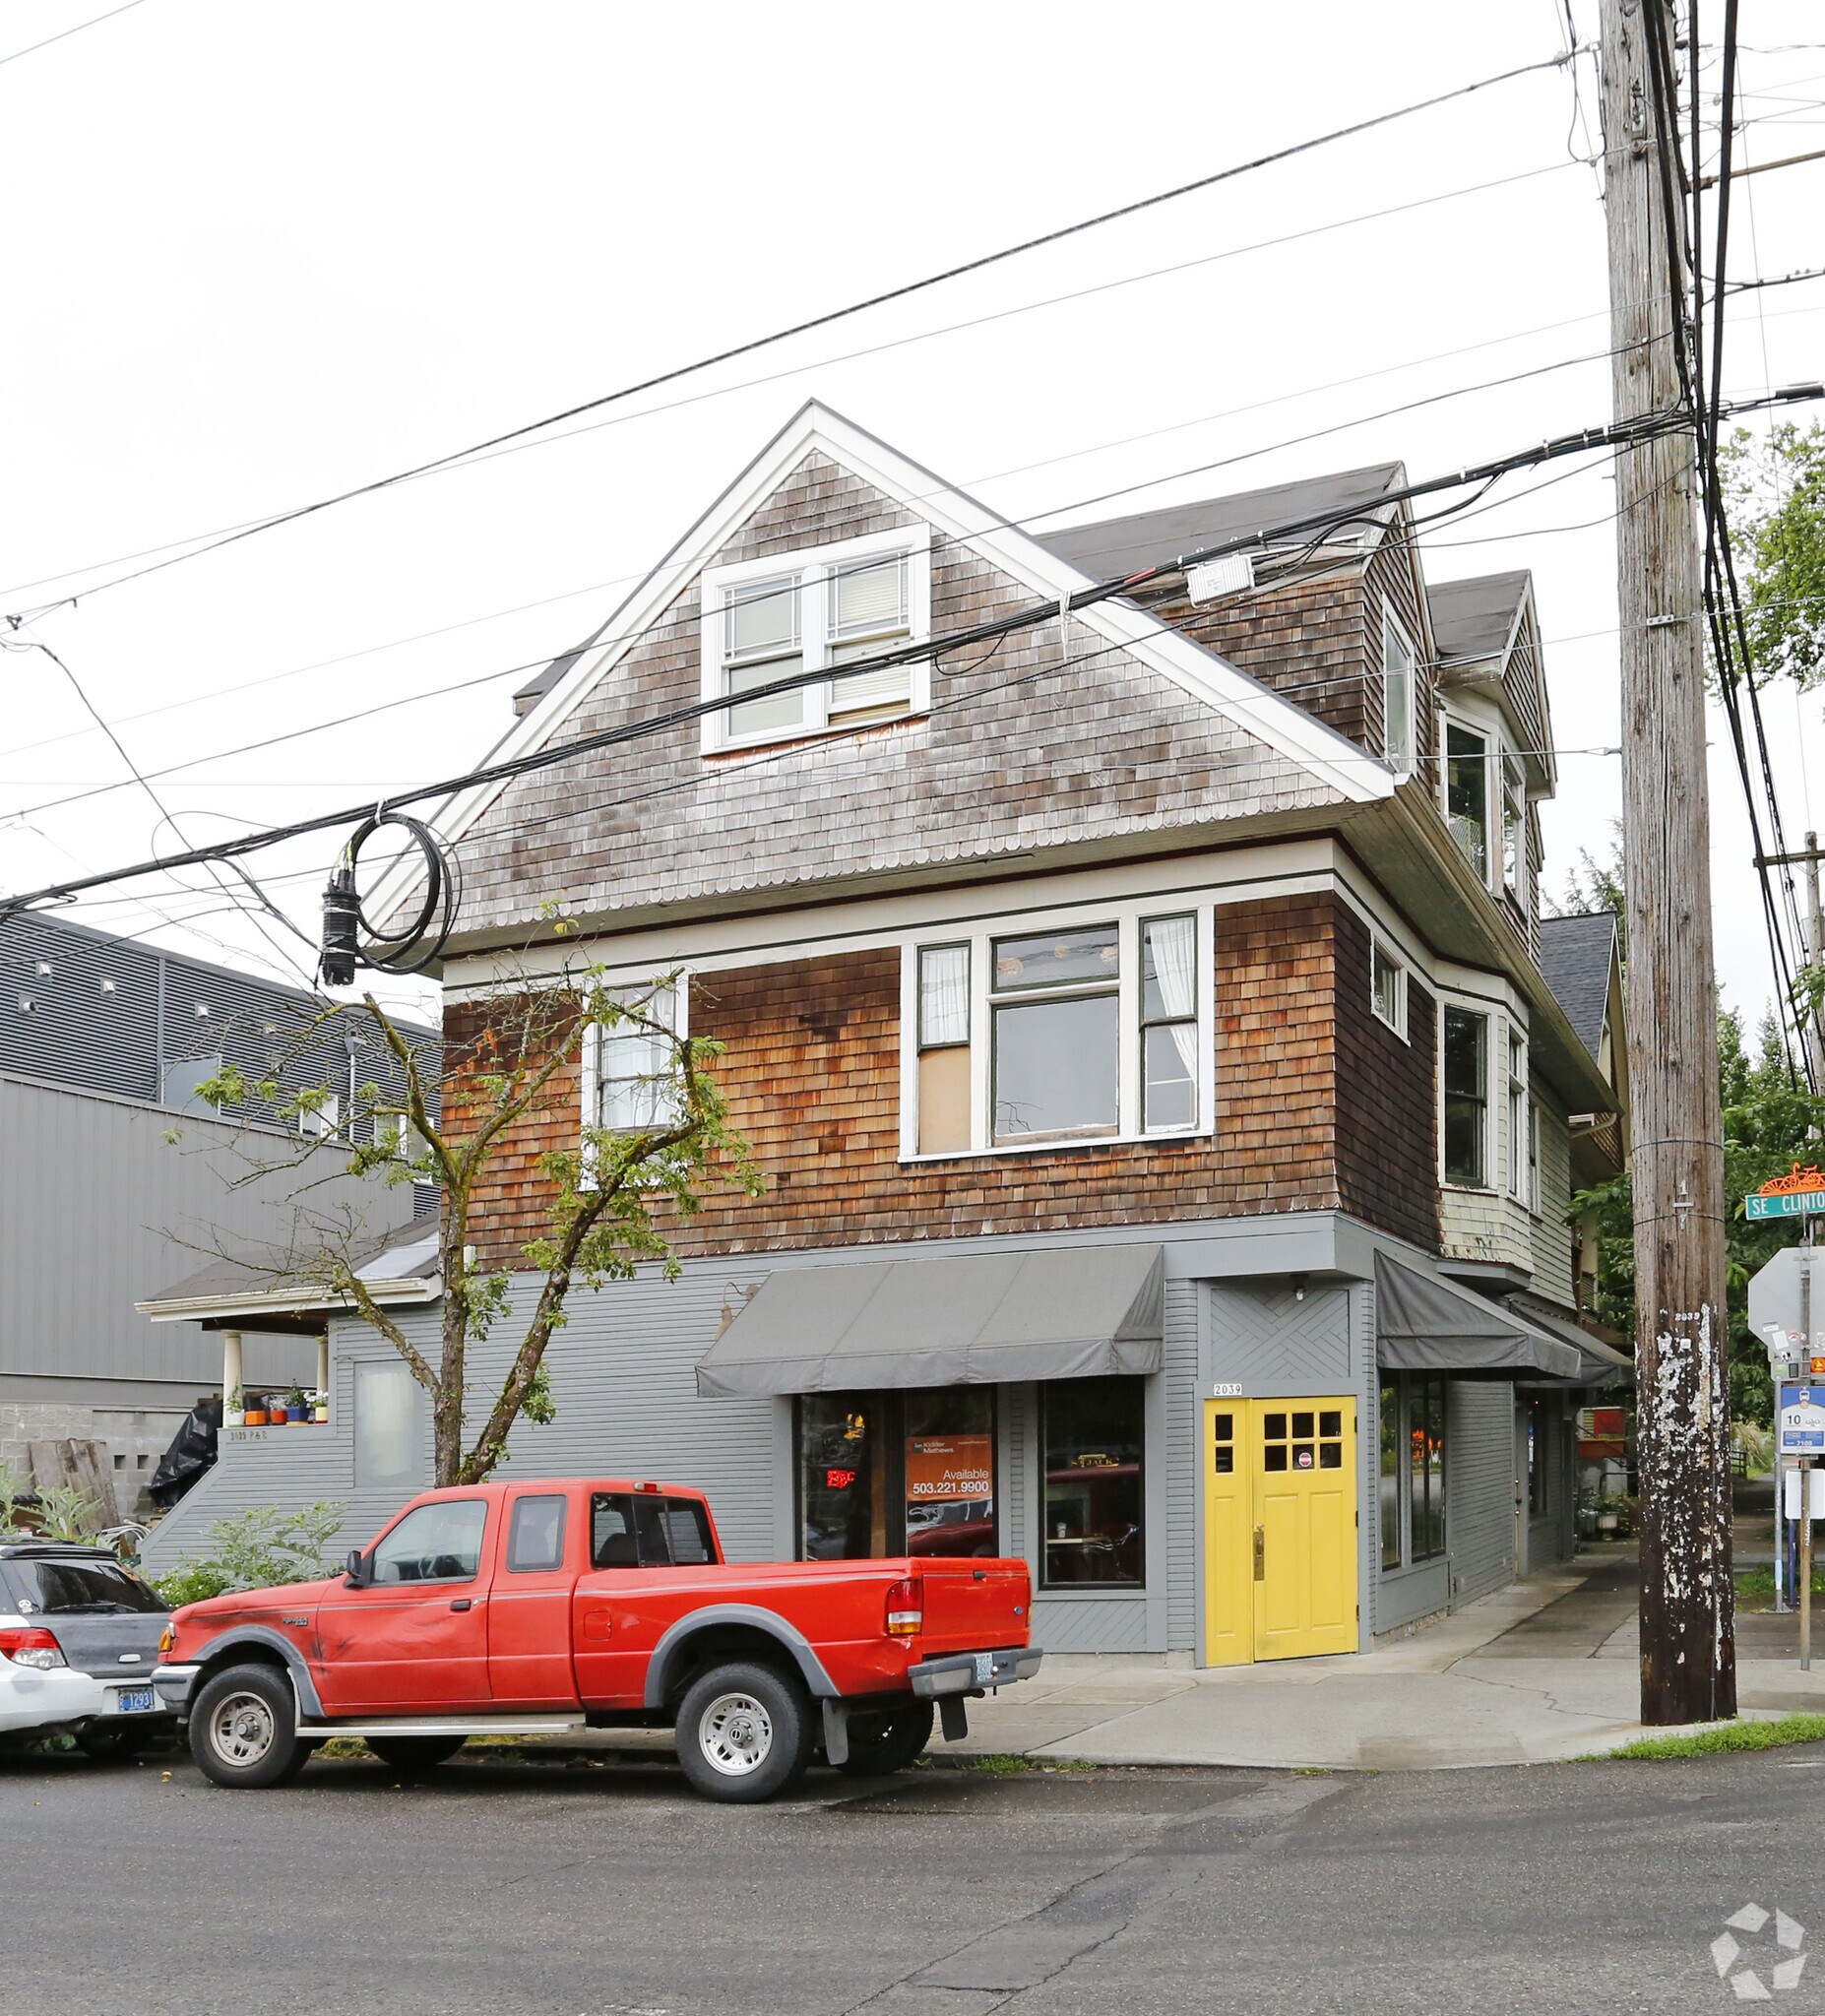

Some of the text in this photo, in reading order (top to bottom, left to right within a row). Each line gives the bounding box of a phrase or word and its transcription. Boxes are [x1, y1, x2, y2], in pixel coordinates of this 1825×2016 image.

[1752, 1191, 1825, 1216] SE CLINTO
[1674, 1311, 1700, 1321] 2039
[1215, 1384, 1241, 1395] 2039
[1787, 1415, 1801, 1425] 10
[942, 1469, 989, 1480] Available
[912, 1480, 989, 1494] 503.221.9900
[130, 1692, 154, 1707] 12931
